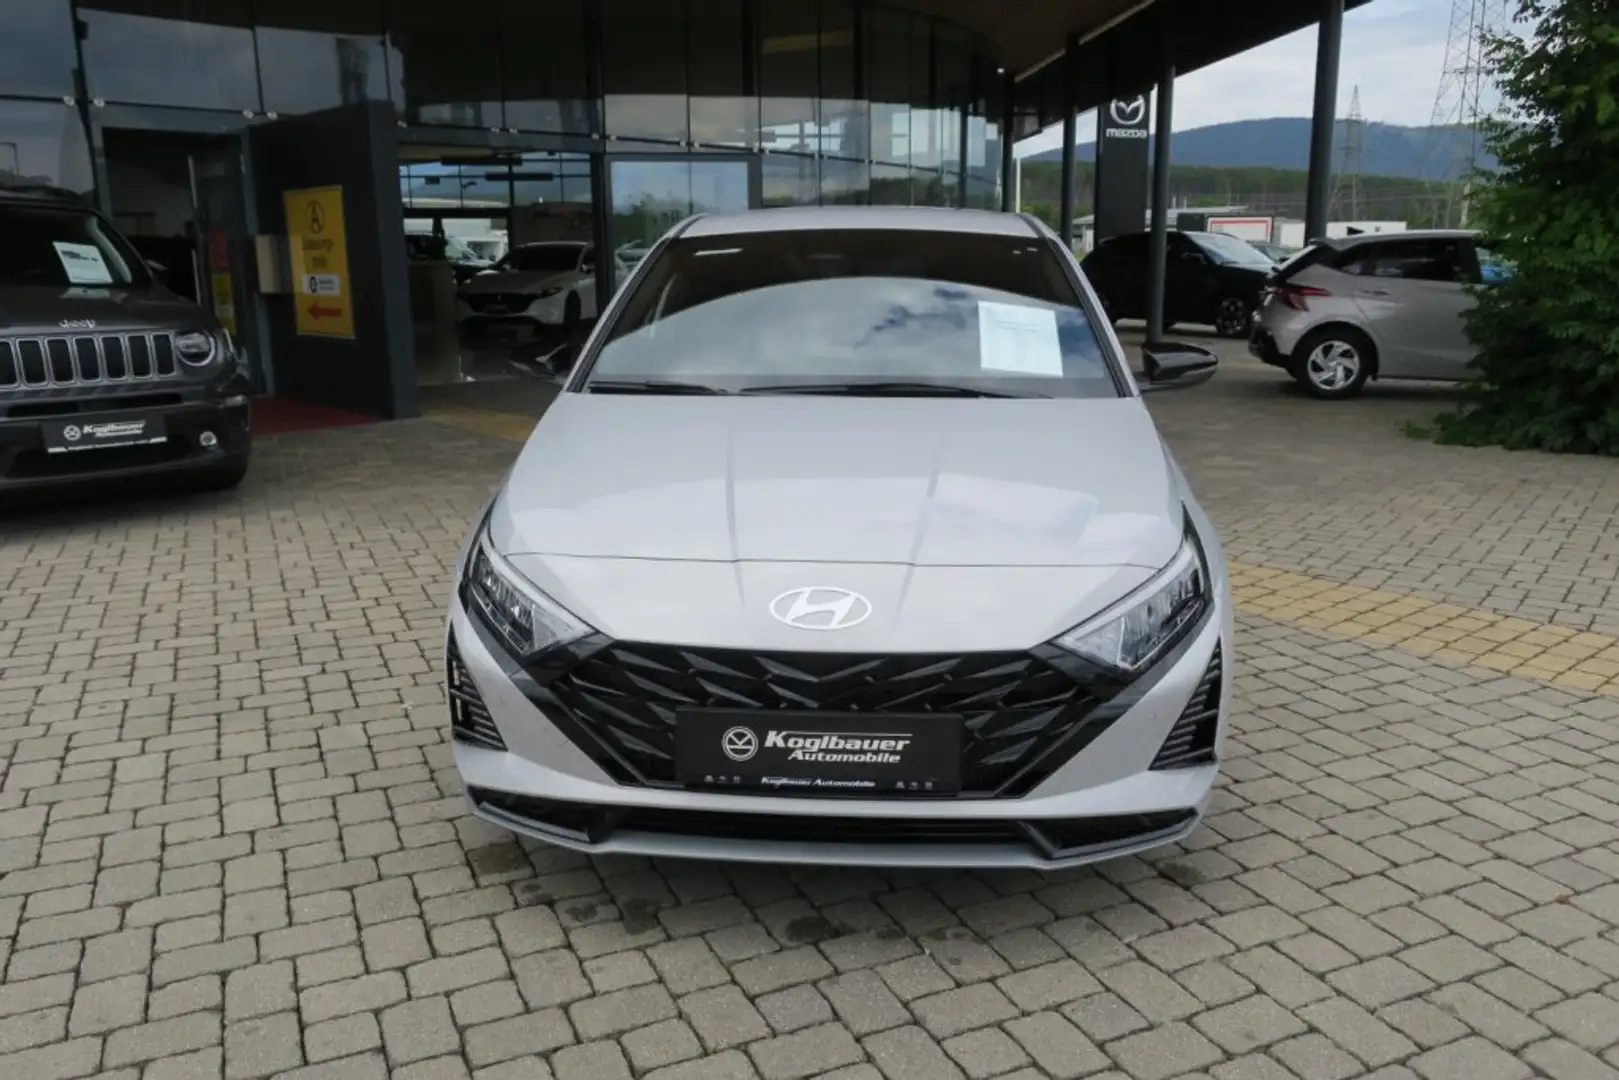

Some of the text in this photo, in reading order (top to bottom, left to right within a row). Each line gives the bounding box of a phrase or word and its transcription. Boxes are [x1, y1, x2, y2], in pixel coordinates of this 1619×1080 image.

[1106, 128, 1148, 139] mazda
[764, 730, 911, 752] Koglbauer
[788, 750, 901, 764] Automobile
[760, 776, 876, 788] Koglbauer Automobile
